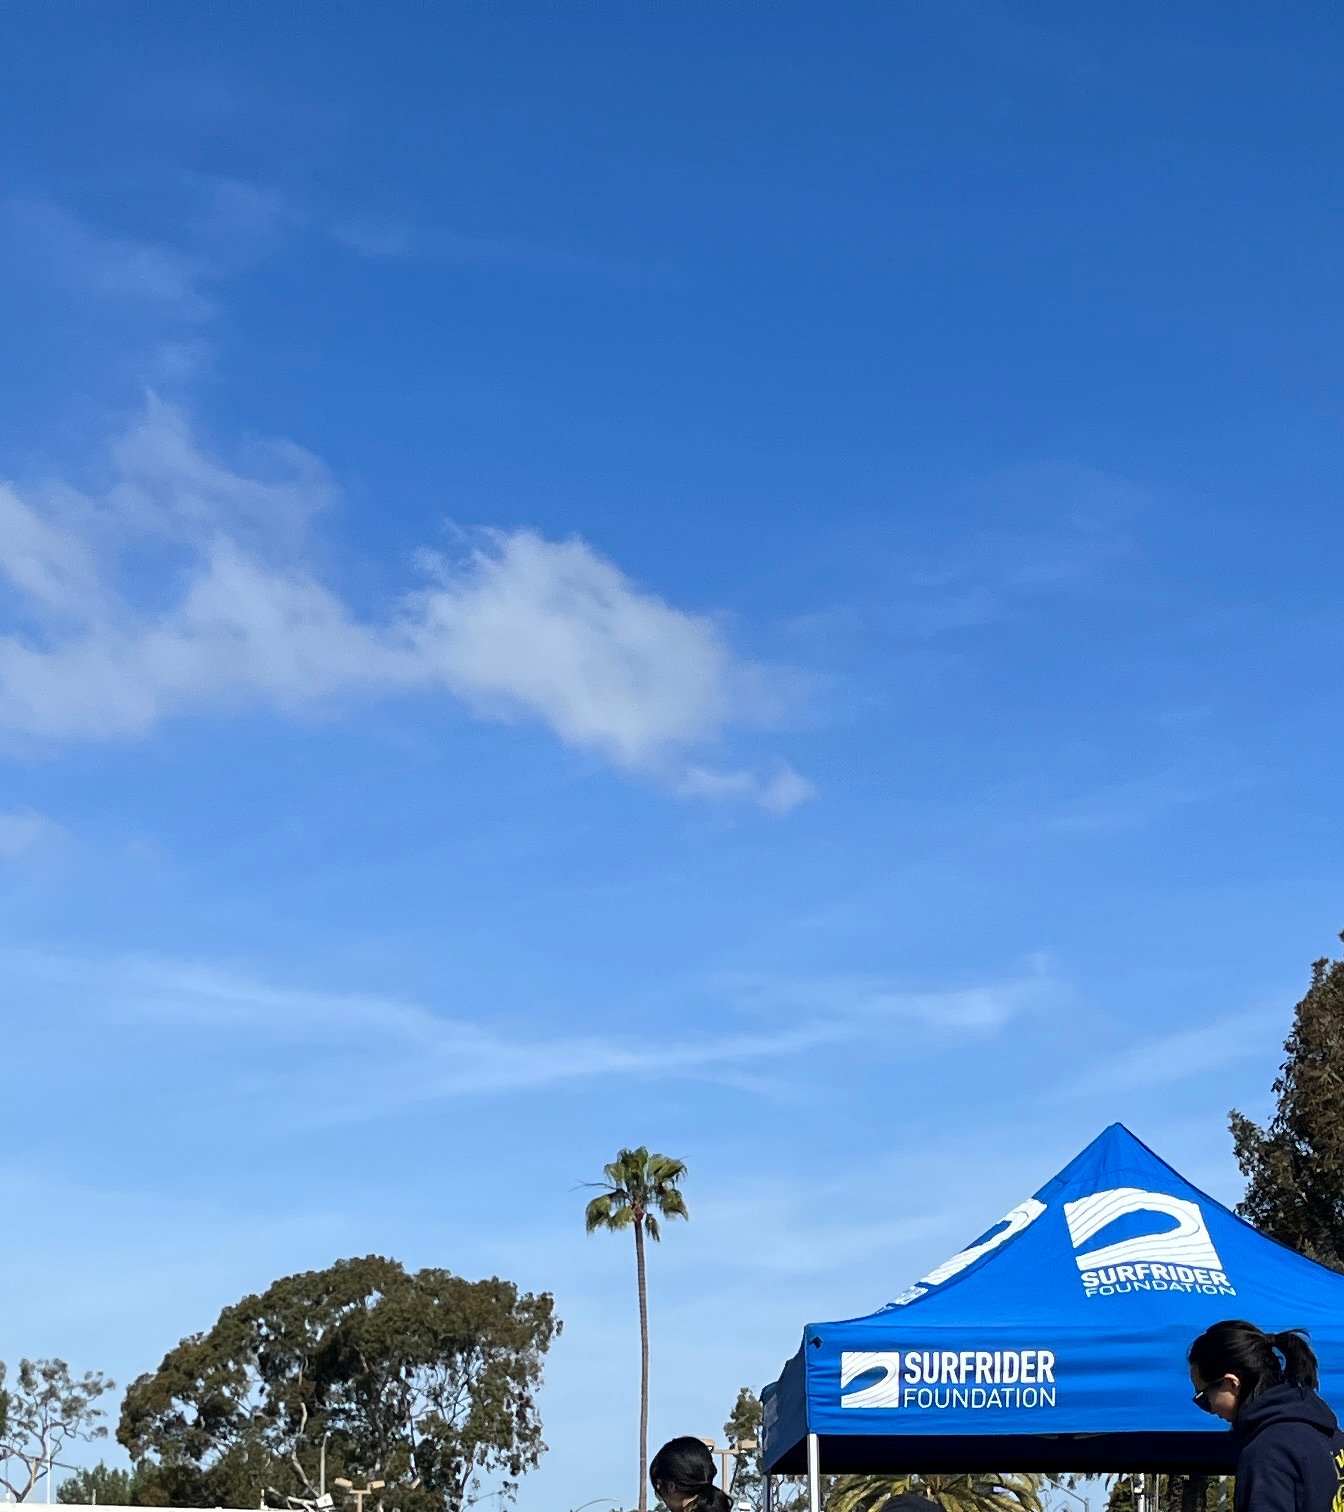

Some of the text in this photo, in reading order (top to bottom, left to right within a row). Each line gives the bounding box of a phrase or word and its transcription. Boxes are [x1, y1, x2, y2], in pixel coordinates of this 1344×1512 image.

[1080, 1263, 1232, 1288] SURFRIDER
[1084, 1279, 1238, 1298] FOUNDATION
[904, 1350, 1055, 1385] SURFRIDER
[903, 1387, 1056, 1409] FOUNDATION
